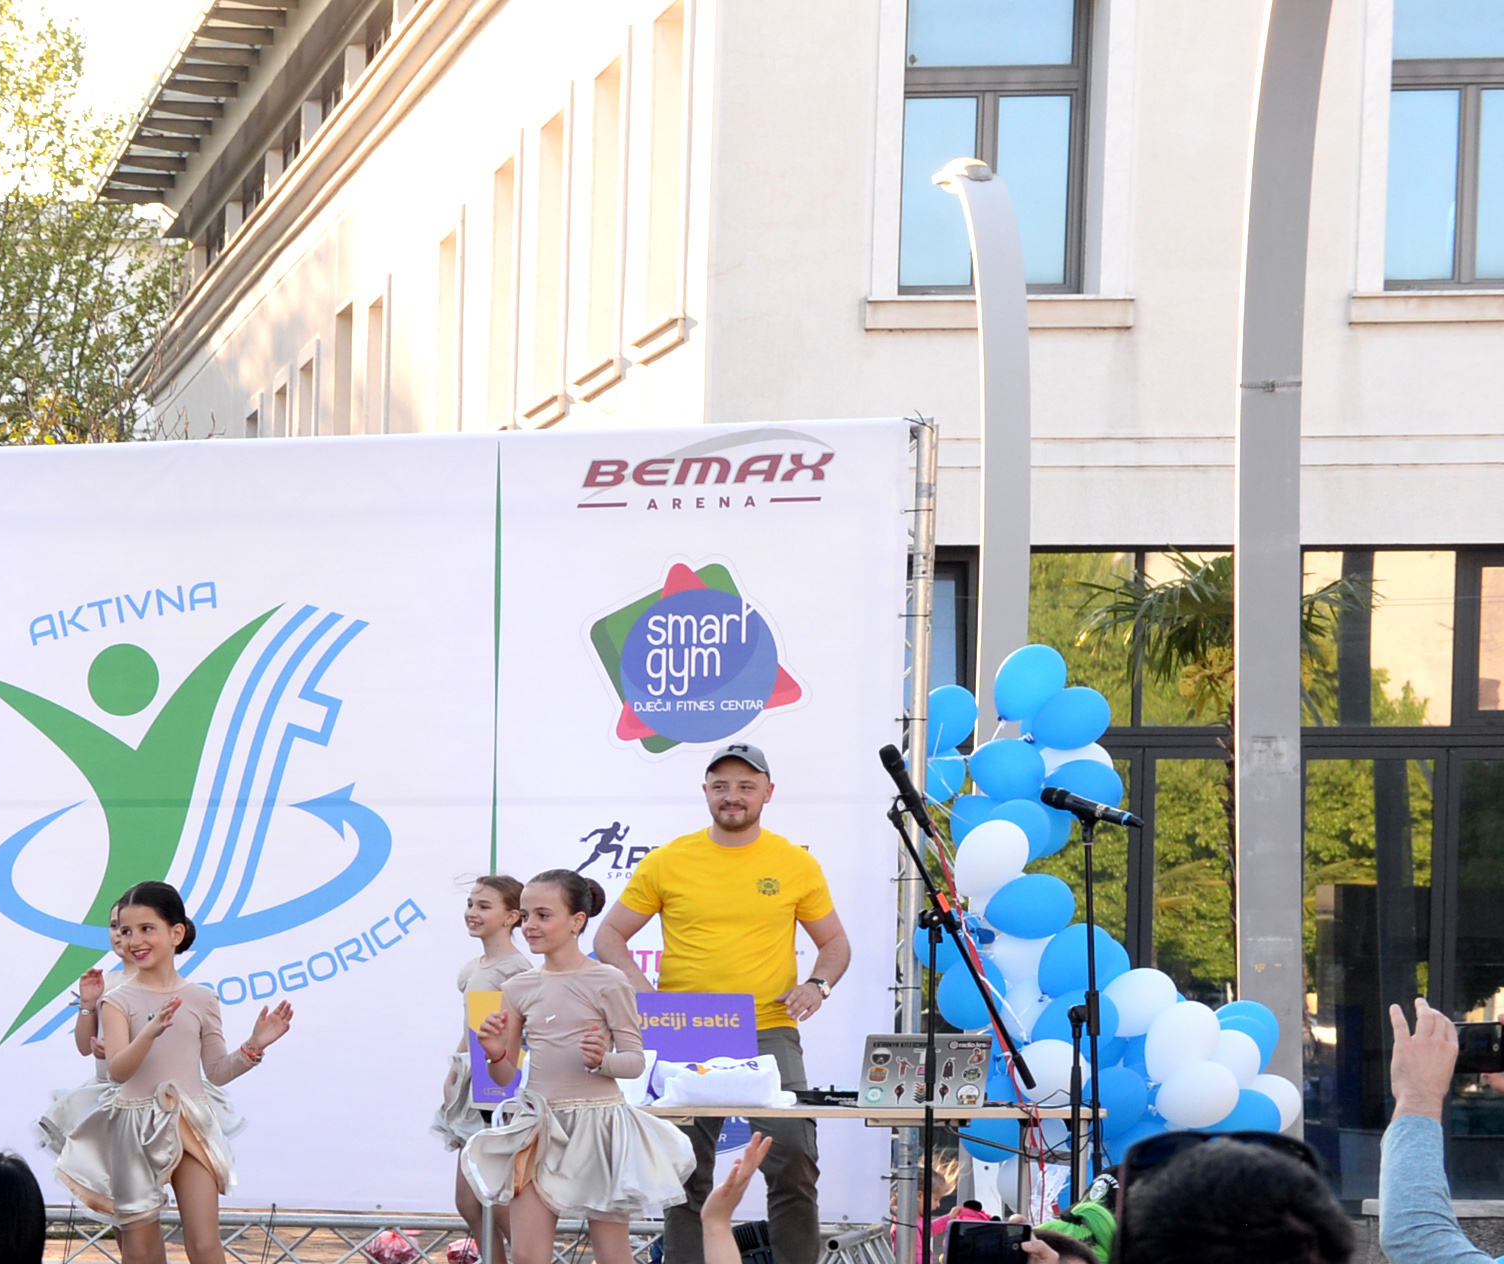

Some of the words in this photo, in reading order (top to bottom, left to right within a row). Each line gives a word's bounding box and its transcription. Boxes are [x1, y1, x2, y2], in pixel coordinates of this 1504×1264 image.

[581, 452, 835, 488] BEMAX
[646, 495, 756, 511] ARENA
[28, 580, 219, 646] AKTIVNA
[646, 599, 754, 645] smart
[645, 645, 721, 697] gym
[633, 698, 672, 713] DJEČJI
[676, 700, 715, 712] FITNES
[720, 699, 764, 712] CENTAR
[692, 1013, 741, 1029] satić
